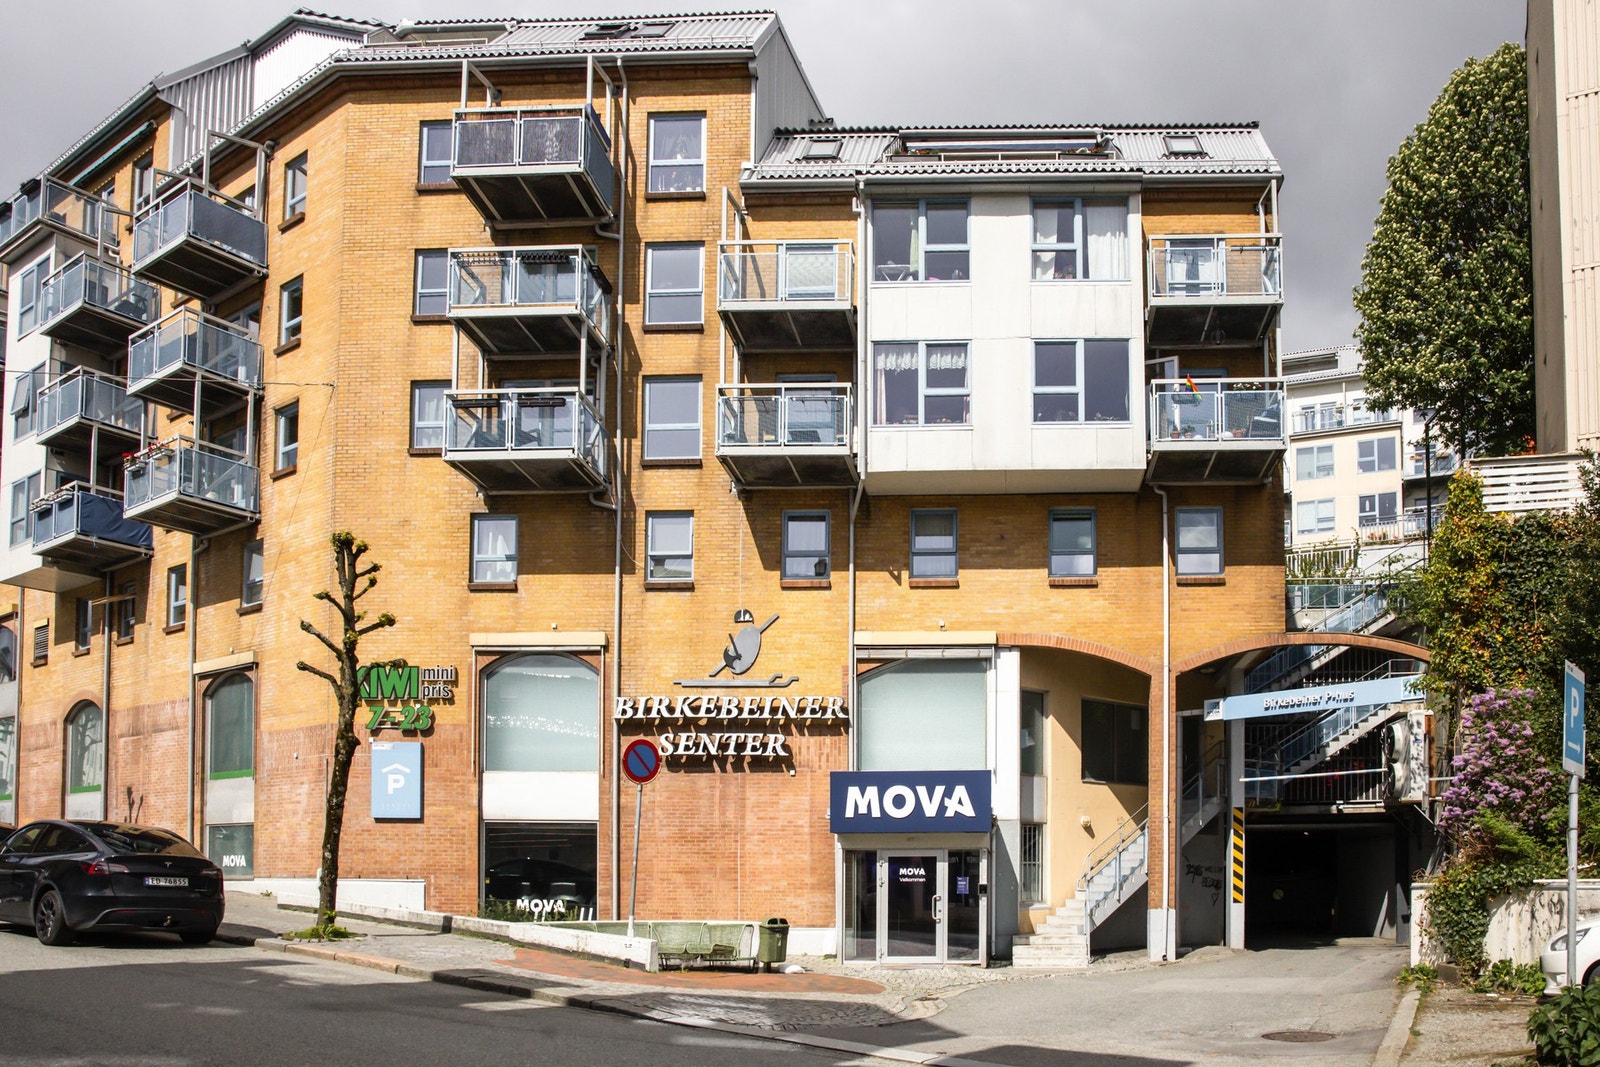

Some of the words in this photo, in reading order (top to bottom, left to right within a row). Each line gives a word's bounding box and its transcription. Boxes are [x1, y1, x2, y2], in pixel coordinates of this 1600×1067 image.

[423, 664, 454, 680] mini
[422, 682, 451, 700] pris
[613, 696, 850, 720] BIRKEBEINER
[1263, 696, 1322, 711] Birkebeiner
[1570, 686, 1580, 728] P
[657, 732, 789, 757] SENTER
[387, 773, 406, 795] P
[845, 785, 976, 818] MOVA
[222, 854, 247, 868] MOVA
[899, 867, 926, 876] MOVA
[163, 878, 187, 886] 76855
[516, 898, 566, 913] MOVA
